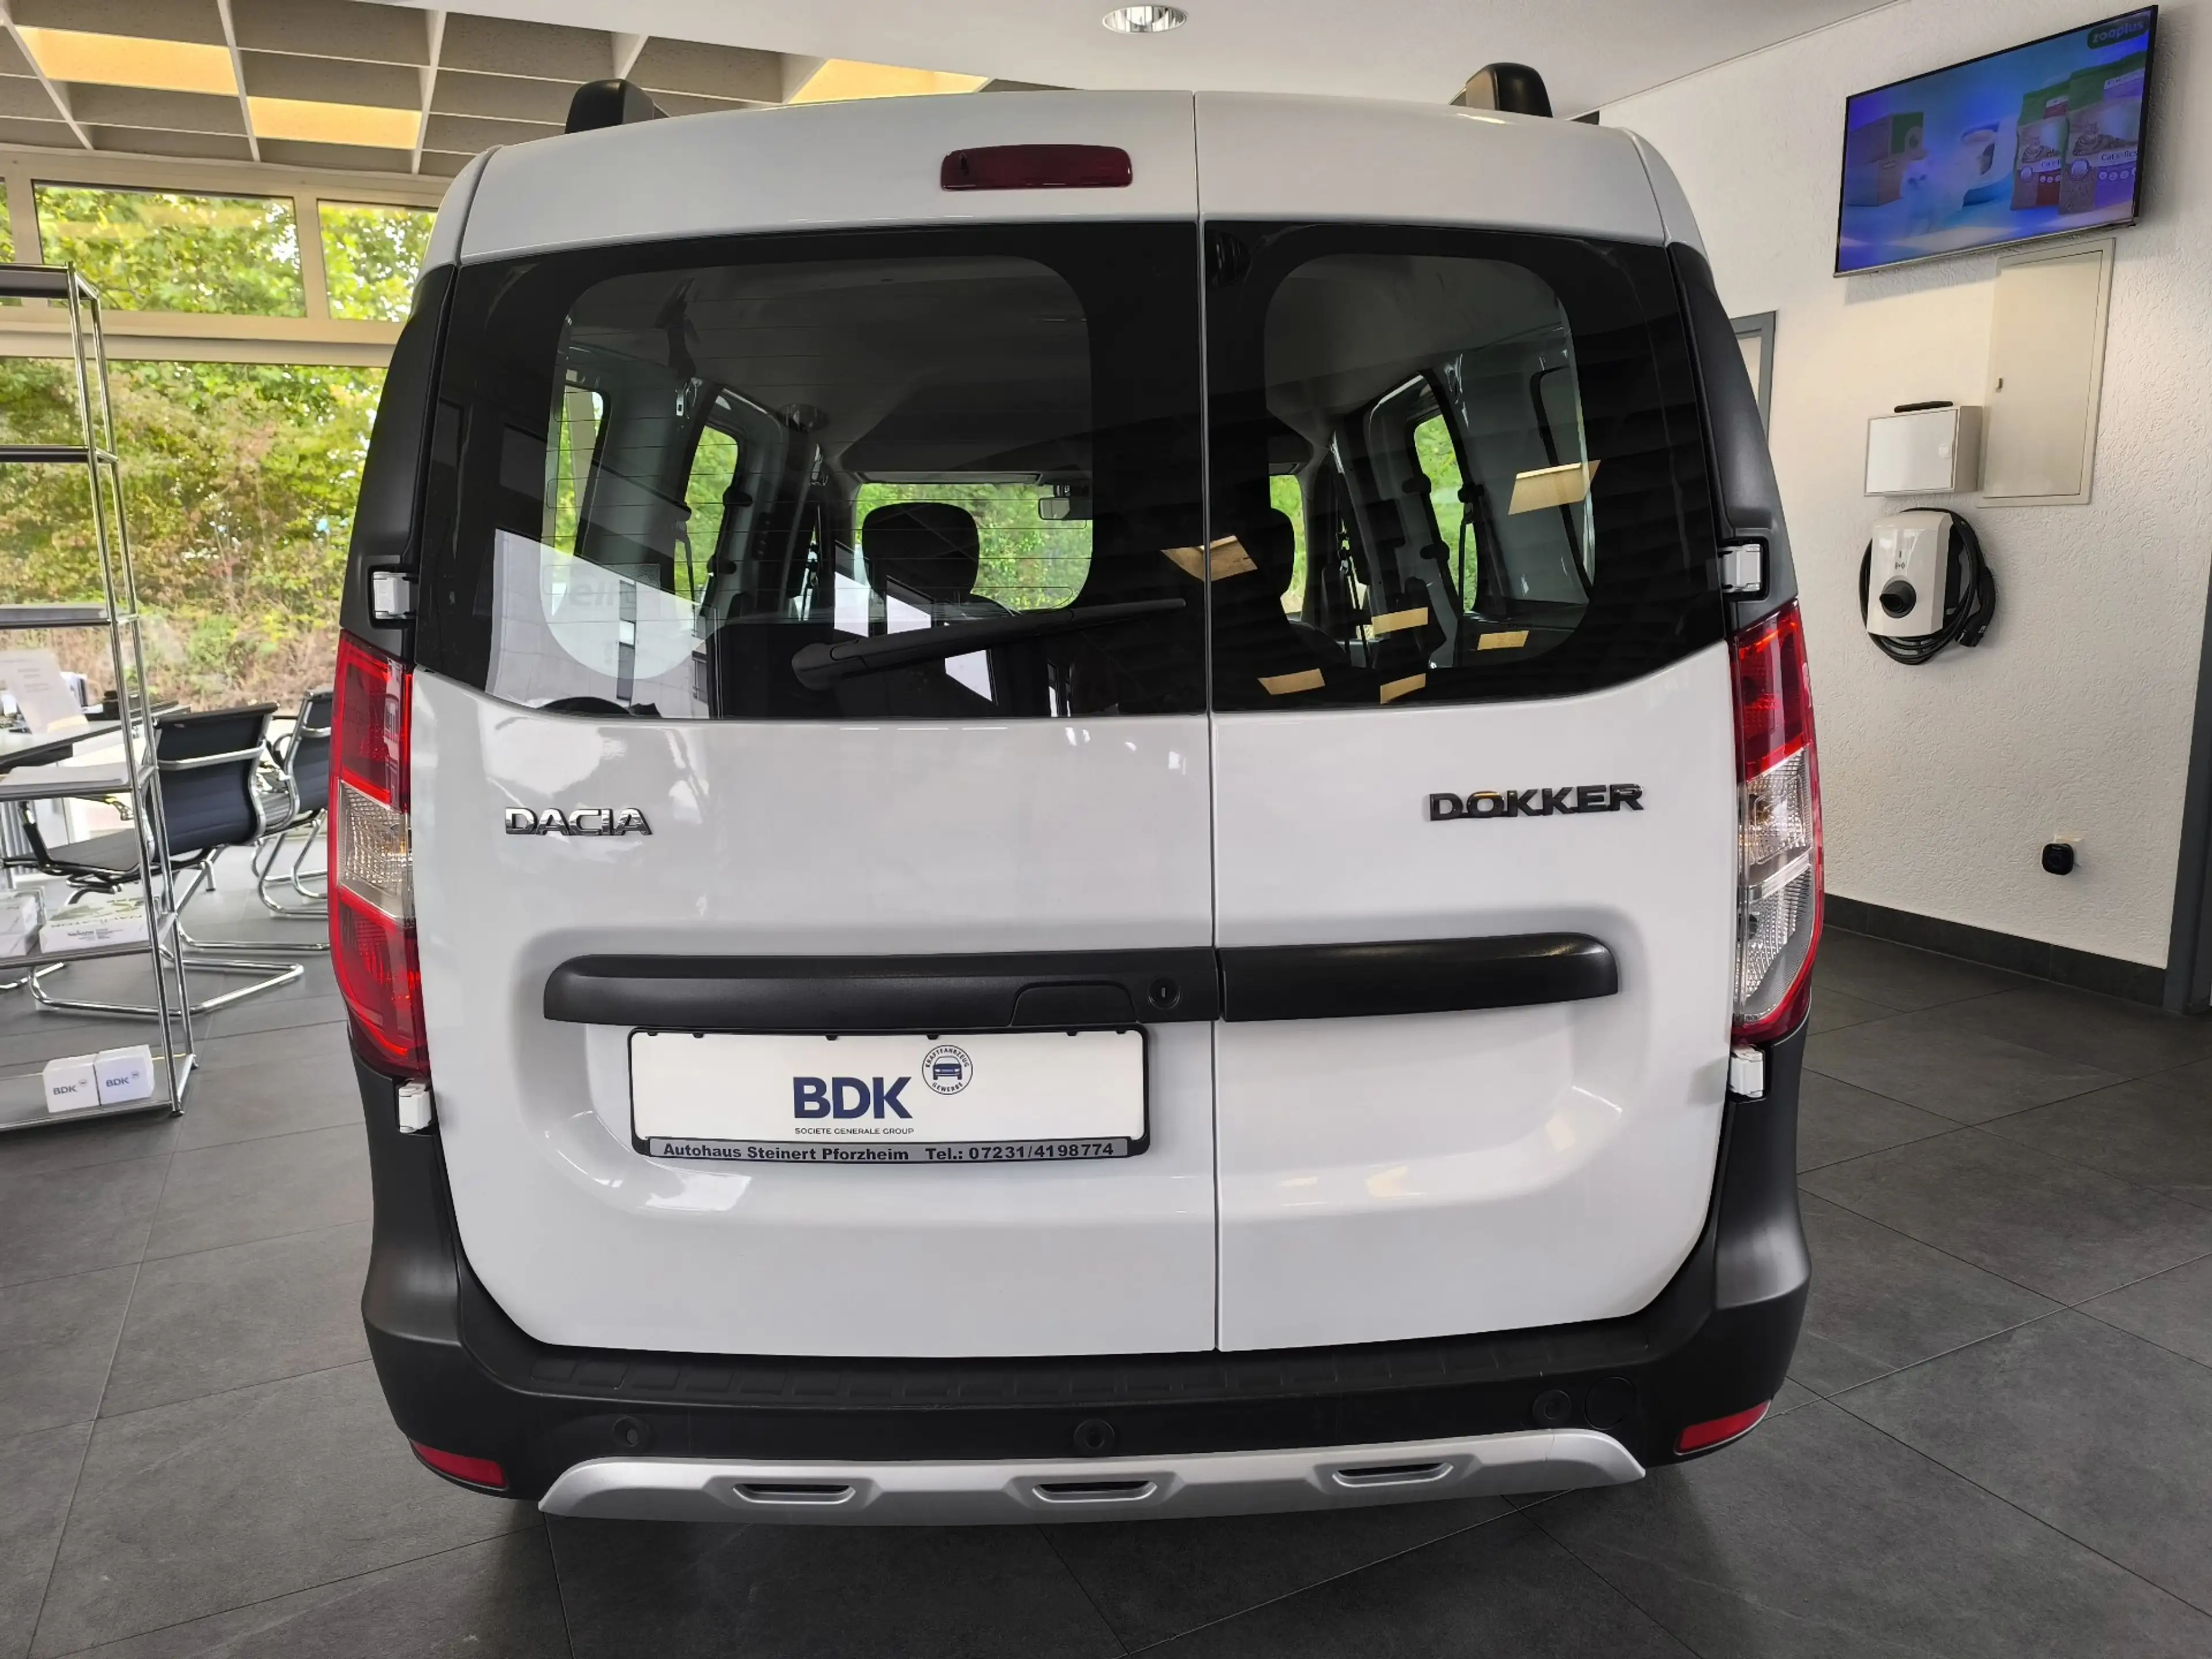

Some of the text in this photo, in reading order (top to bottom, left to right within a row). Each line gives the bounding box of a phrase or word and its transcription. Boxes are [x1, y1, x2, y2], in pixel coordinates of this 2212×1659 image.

[2092, 22, 2143, 44] zooplus
[1430, 783, 1644, 821] DOKKER
[505, 806, 653, 835] DACIA
[925, 1047, 969, 1067] KRAFTFAHRZEUG
[53, 1085, 77, 1095] BDK
[106, 1077, 130, 1088] BDK
[931, 1082, 963, 1092] GEWERBE
[793, 1076, 914, 1119] BDK
[663, 1143, 1114, 1161] Autohaus Steinert Pforzheim Tel.: 07231/4198774
